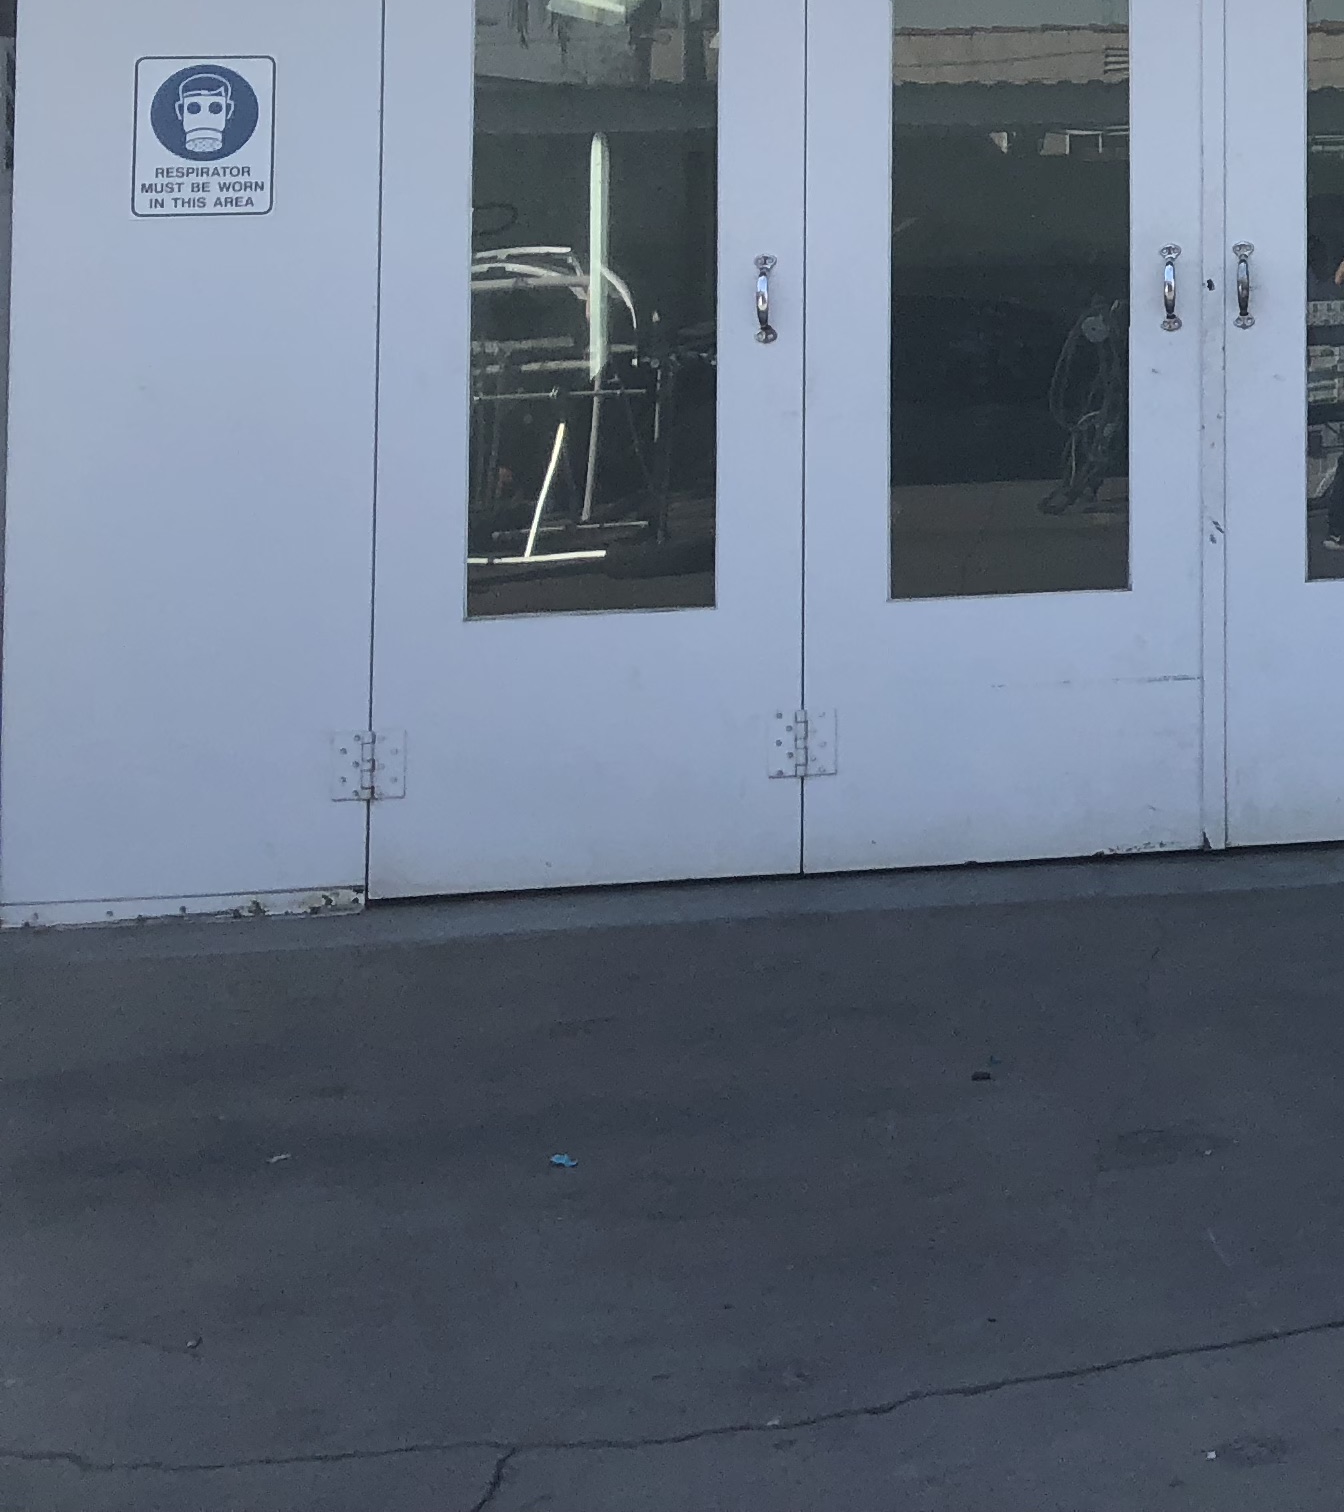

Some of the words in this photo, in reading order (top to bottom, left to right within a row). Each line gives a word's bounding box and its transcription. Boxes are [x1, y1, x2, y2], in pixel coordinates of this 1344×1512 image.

[155, 166, 251, 178] RESPIRATOR
[140, 182, 184, 194] MUST
[191, 182, 210, 193] BE
[218, 181, 264, 192] WORN
[149, 198, 164, 208] IN
[171, 197, 206, 208] THIS
[213, 196, 254, 207] AREA
